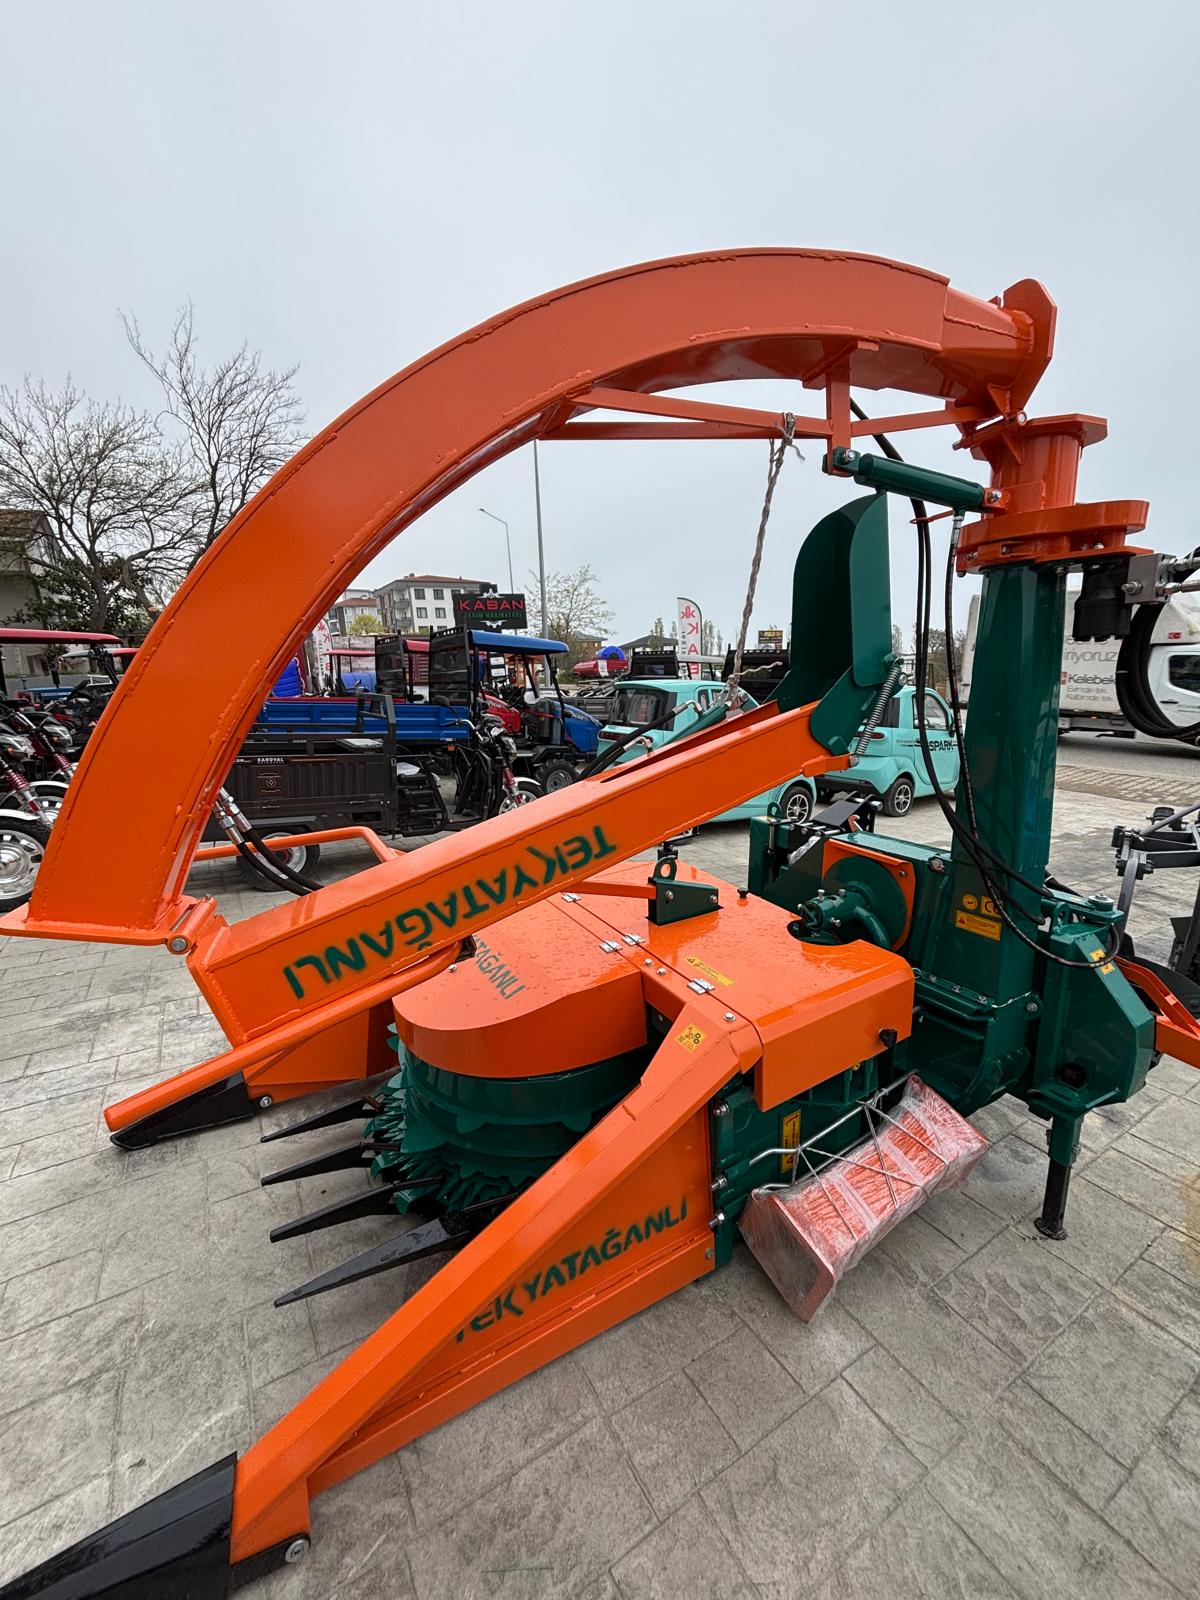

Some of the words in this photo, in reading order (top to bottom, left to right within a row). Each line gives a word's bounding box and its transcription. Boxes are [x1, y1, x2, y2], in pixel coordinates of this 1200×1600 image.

[459, 600, 525, 610] KABAN
[929, 741, 954, 751] SPARK
[474, 934, 526, 999] TAĞANLI
